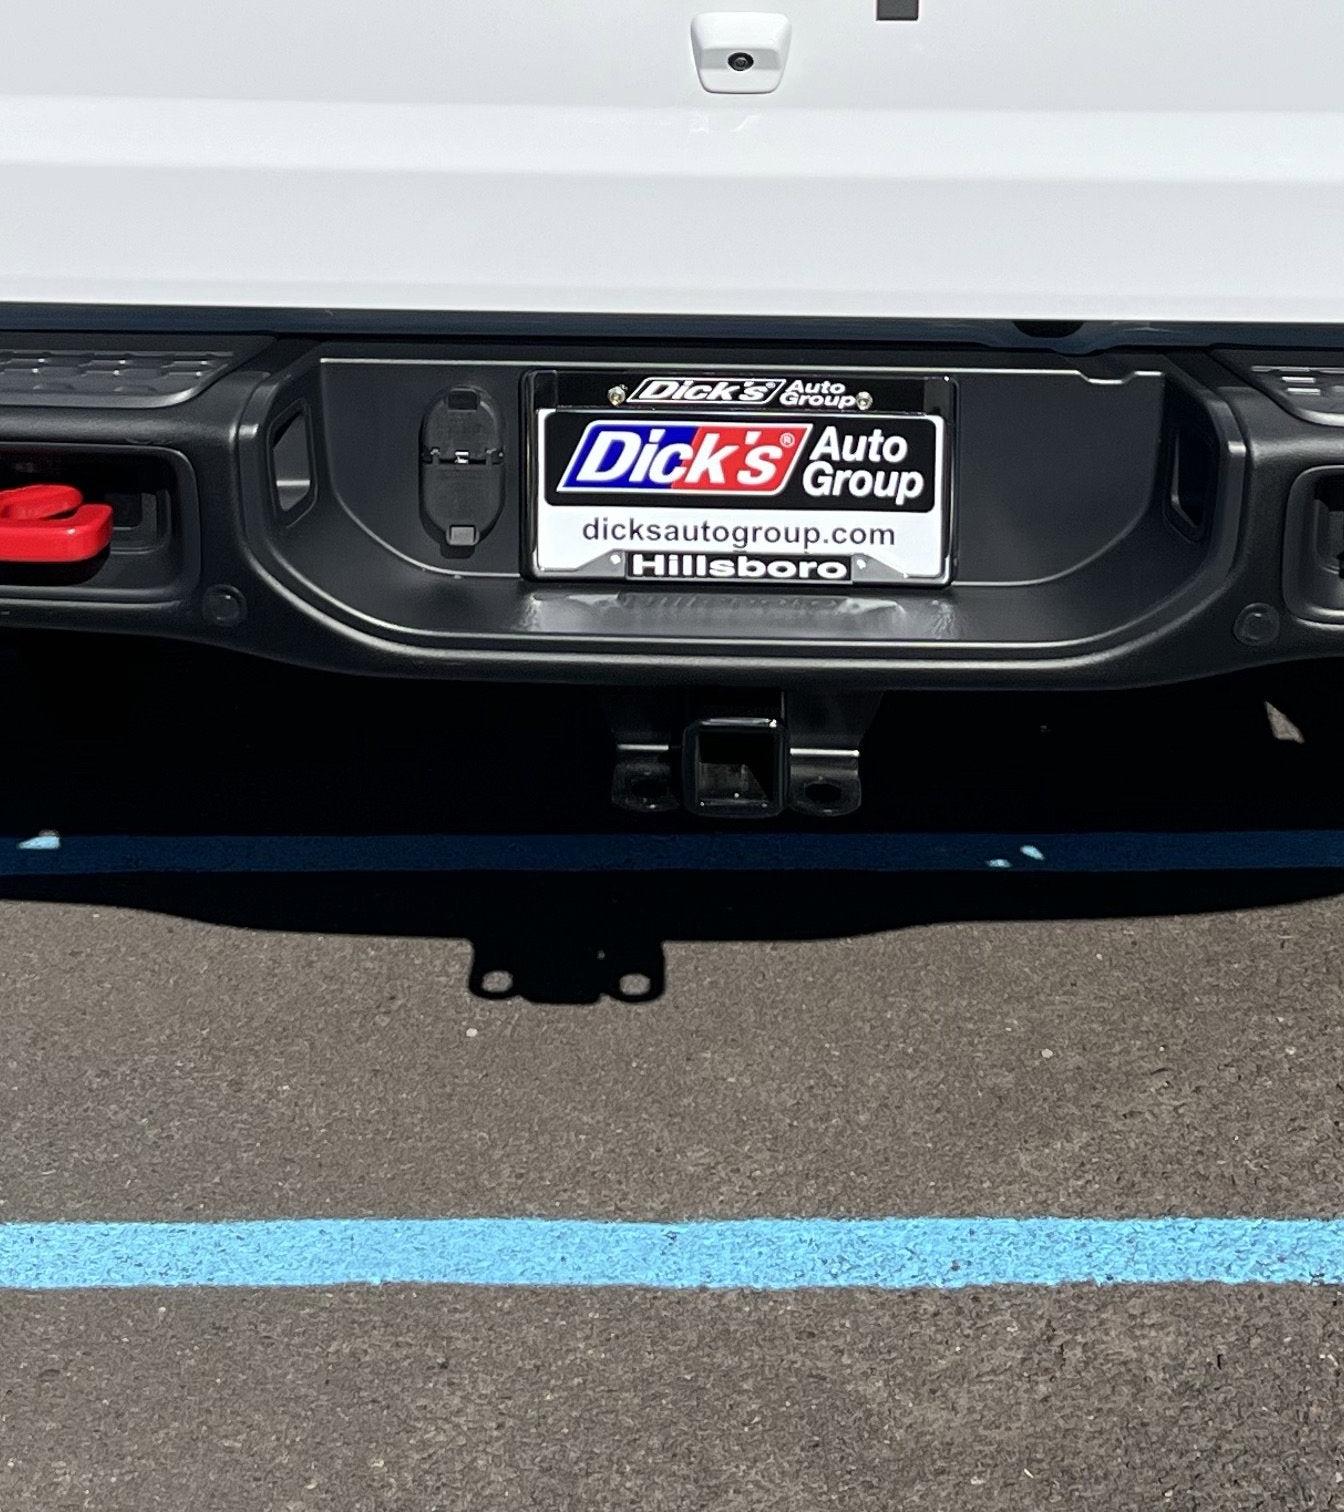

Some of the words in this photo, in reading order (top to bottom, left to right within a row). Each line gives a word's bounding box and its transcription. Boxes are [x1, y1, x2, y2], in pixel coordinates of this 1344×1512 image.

[638, 380, 769, 401] Dick's
[778, 391, 857, 410] Group
[784, 379, 846, 394] Auto
[575, 427, 785, 486] Dick's
[808, 425, 907, 463] Auto
[802, 460, 924, 505] Group
[582, 516, 896, 549] dicksautogroup.com
[631, 553, 849, 580] Hillsboro
